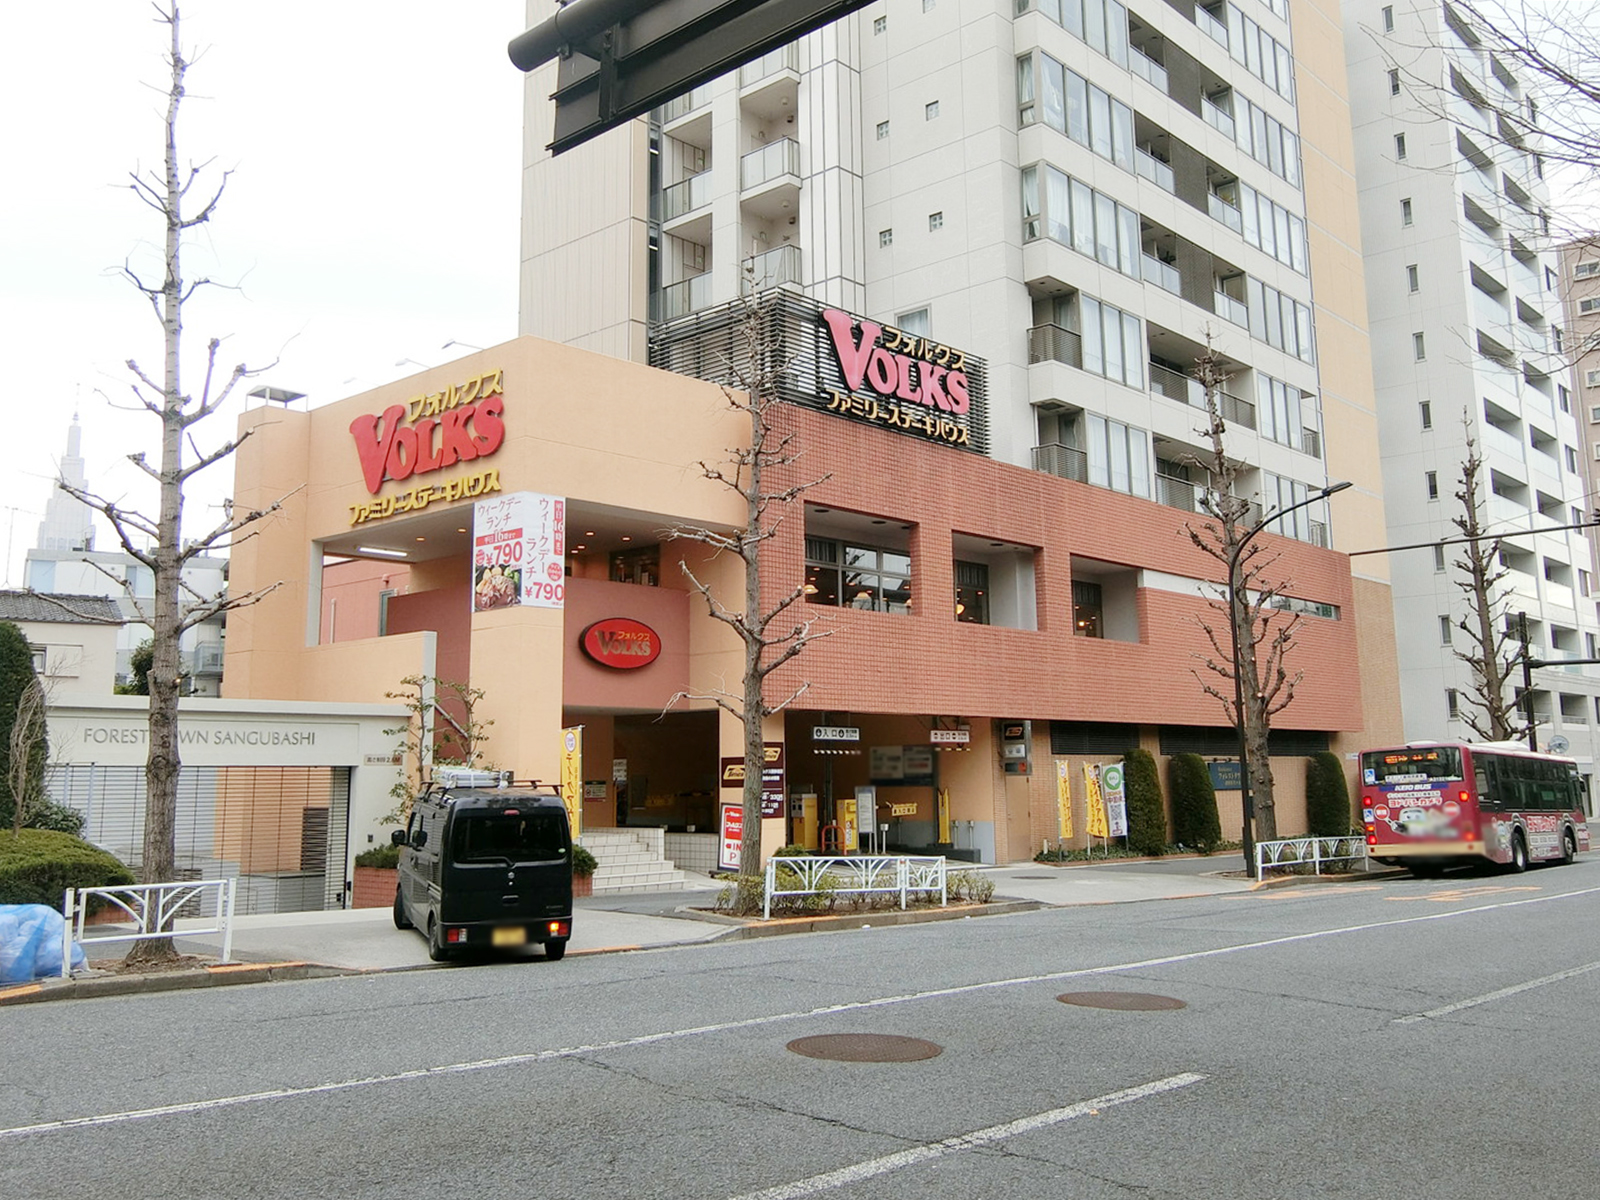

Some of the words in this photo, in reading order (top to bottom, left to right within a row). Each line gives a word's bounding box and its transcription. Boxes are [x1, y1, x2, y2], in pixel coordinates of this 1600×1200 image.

[822, 308, 970, 415] VOLKS
[884, 326, 967, 372] フォルクス
[408, 368, 503, 423] フォルクス
[825, 388, 970, 445] ファミリーステーキハウス
[349, 396, 505, 494] VOLKS
[348, 468, 502, 526] ファミリーステーキハウス
[478, 497, 521, 517] ウィークデー
[486, 512, 511, 530] ランチ
[539, 498, 550, 573] ウィークデー
[486, 541, 523, 566] ¥790
[525, 538, 537, 579] ランチ
[525, 581, 565, 601] ¥790
[595, 629, 651, 656] VOLKS
[617, 630, 650, 640] フォルクス
[83, 728, 149, 744] FOREST
[213, 730, 315, 746] SANGUBASHI
